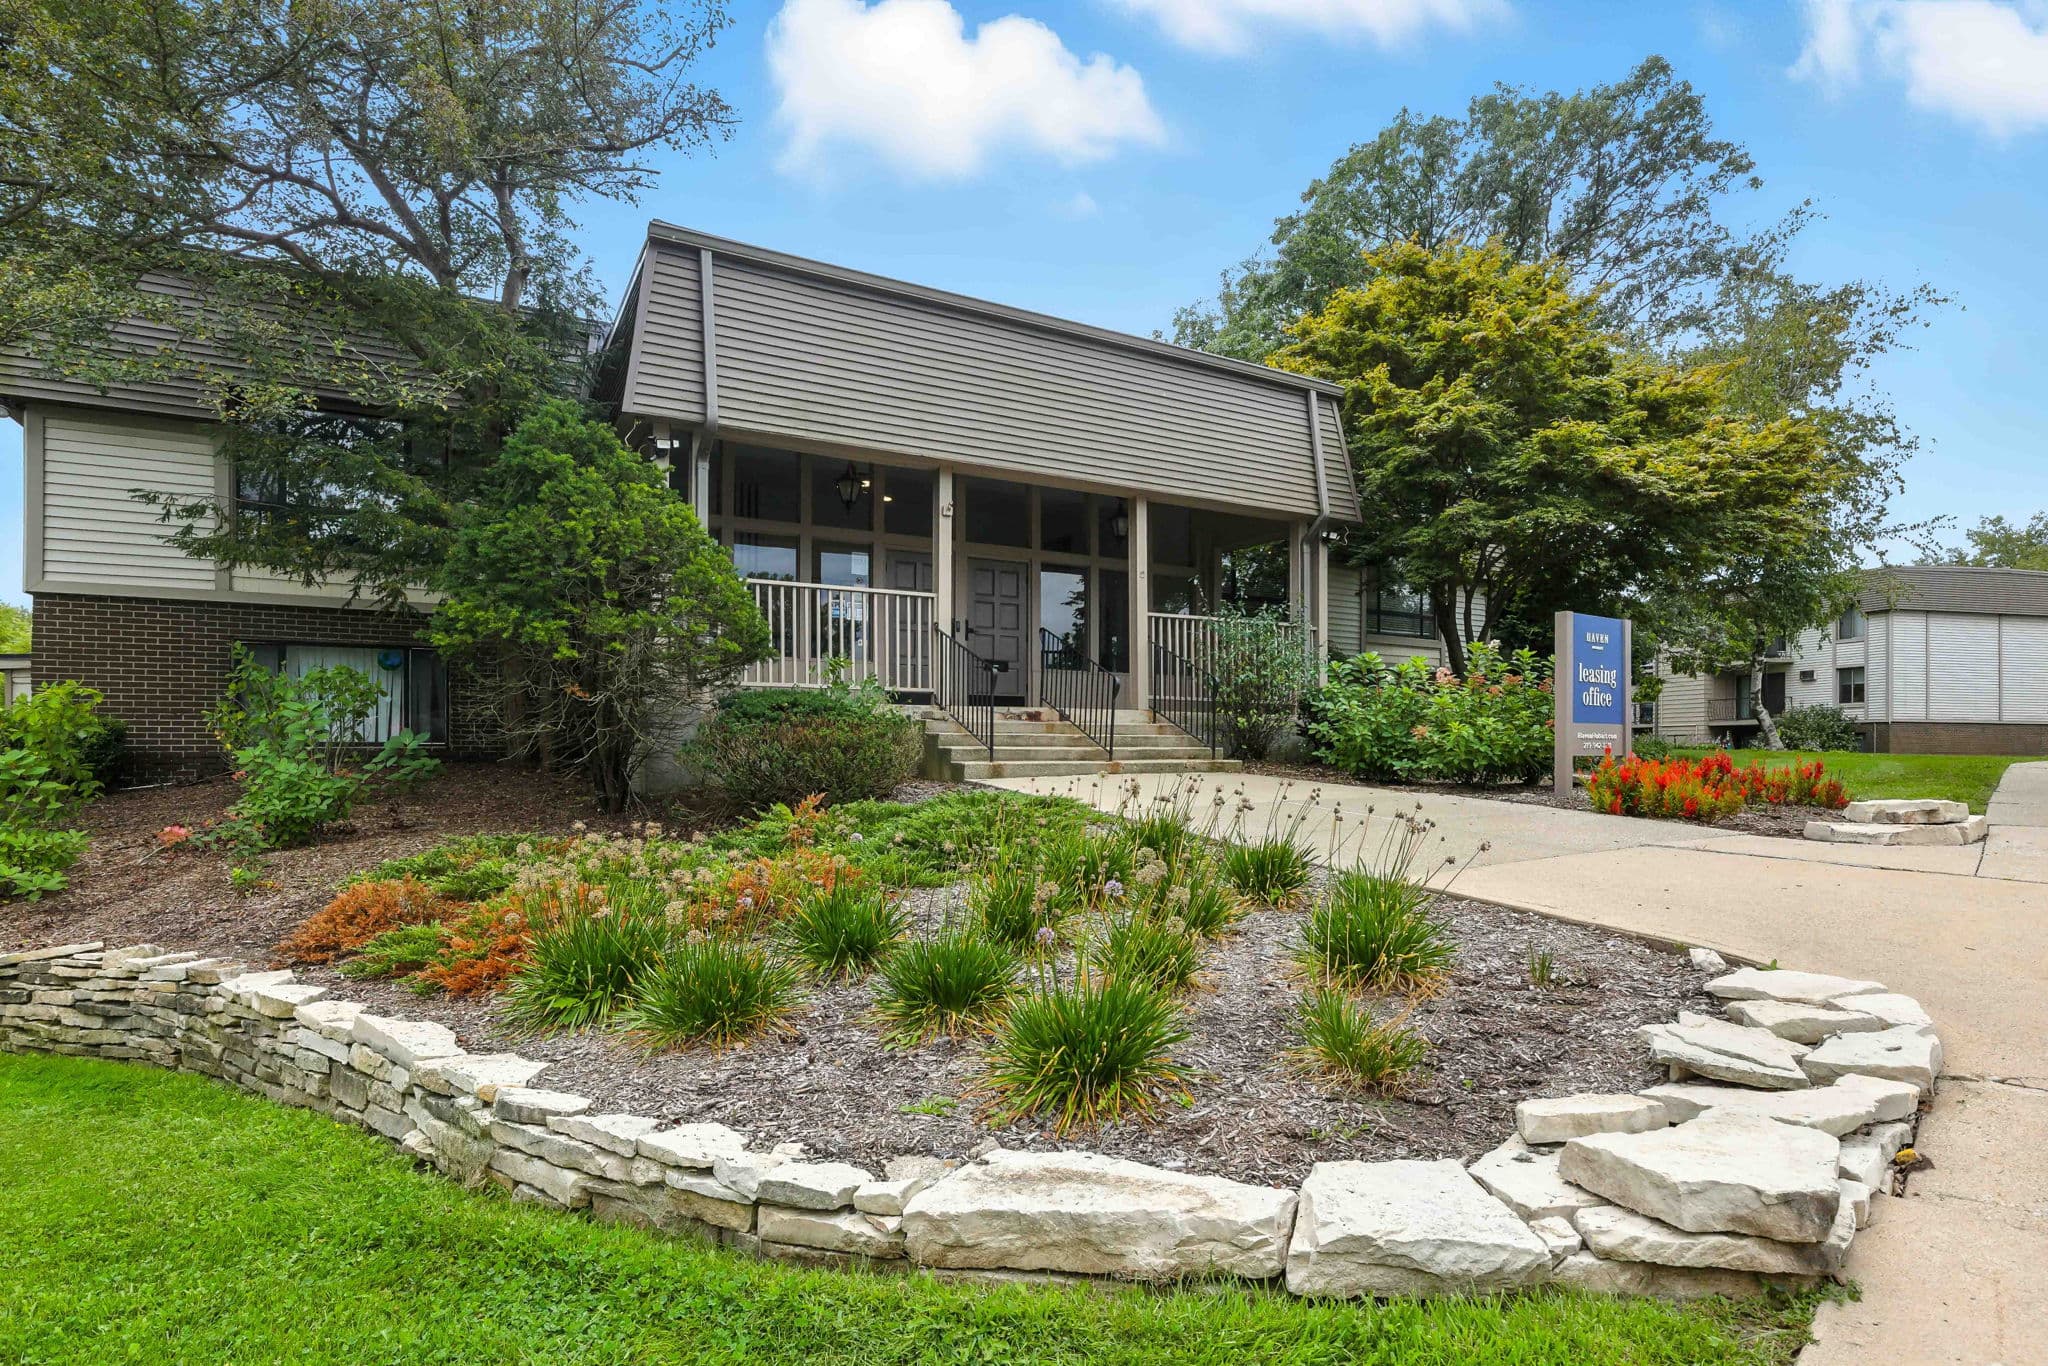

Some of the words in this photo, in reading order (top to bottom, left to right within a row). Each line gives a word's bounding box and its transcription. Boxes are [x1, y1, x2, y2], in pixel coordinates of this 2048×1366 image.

[1586, 632, 1609, 644] HAVEN
[1579, 662, 1617, 689] leasing
[1583, 686, 1612, 707] office
